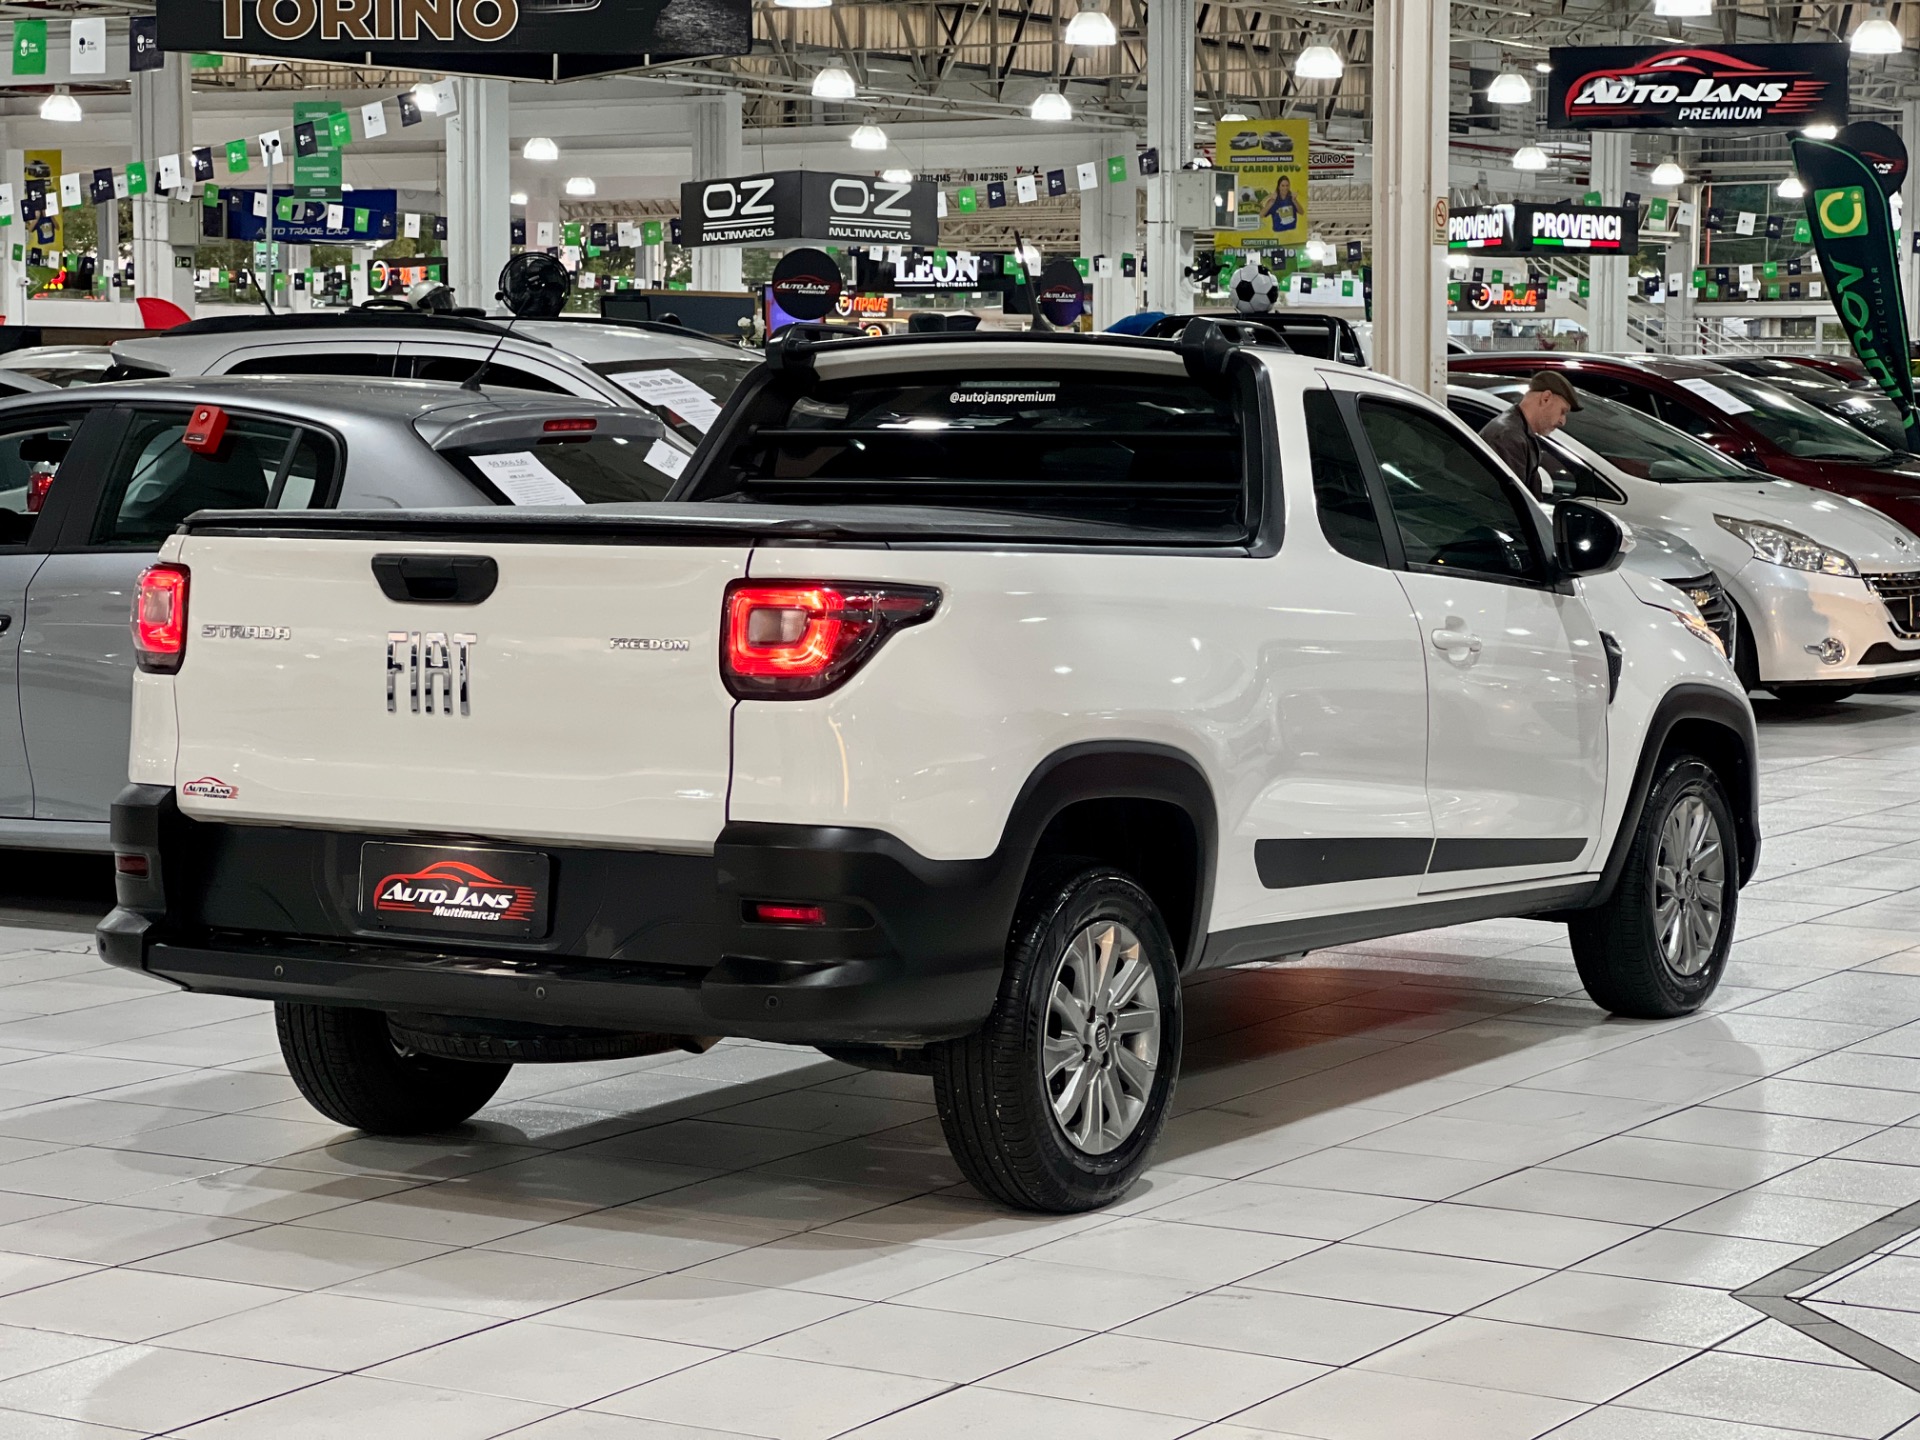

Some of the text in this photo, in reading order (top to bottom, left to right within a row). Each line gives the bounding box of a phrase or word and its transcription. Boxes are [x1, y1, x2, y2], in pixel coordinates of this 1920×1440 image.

[1678, 107, 1762, 120] PREMIUM
[288, 227, 324, 235] TRADE
[326, 227, 350, 235] CAR
[1449, 213, 1504, 241] PROVENCI
[1532, 212, 1621, 240] PROVENCI
[703, 227, 775, 241] MULTIMARCAS
[829, 227, 912, 240] MULTIMARCAS
[949, 391, 1056, 404] @autojanspremium
[201, 624, 291, 640] STRADA
[609, 638, 690, 651] FREEDOM
[387, 632, 477, 715] FIAT
[433, 905, 501, 921] Multimarcas
